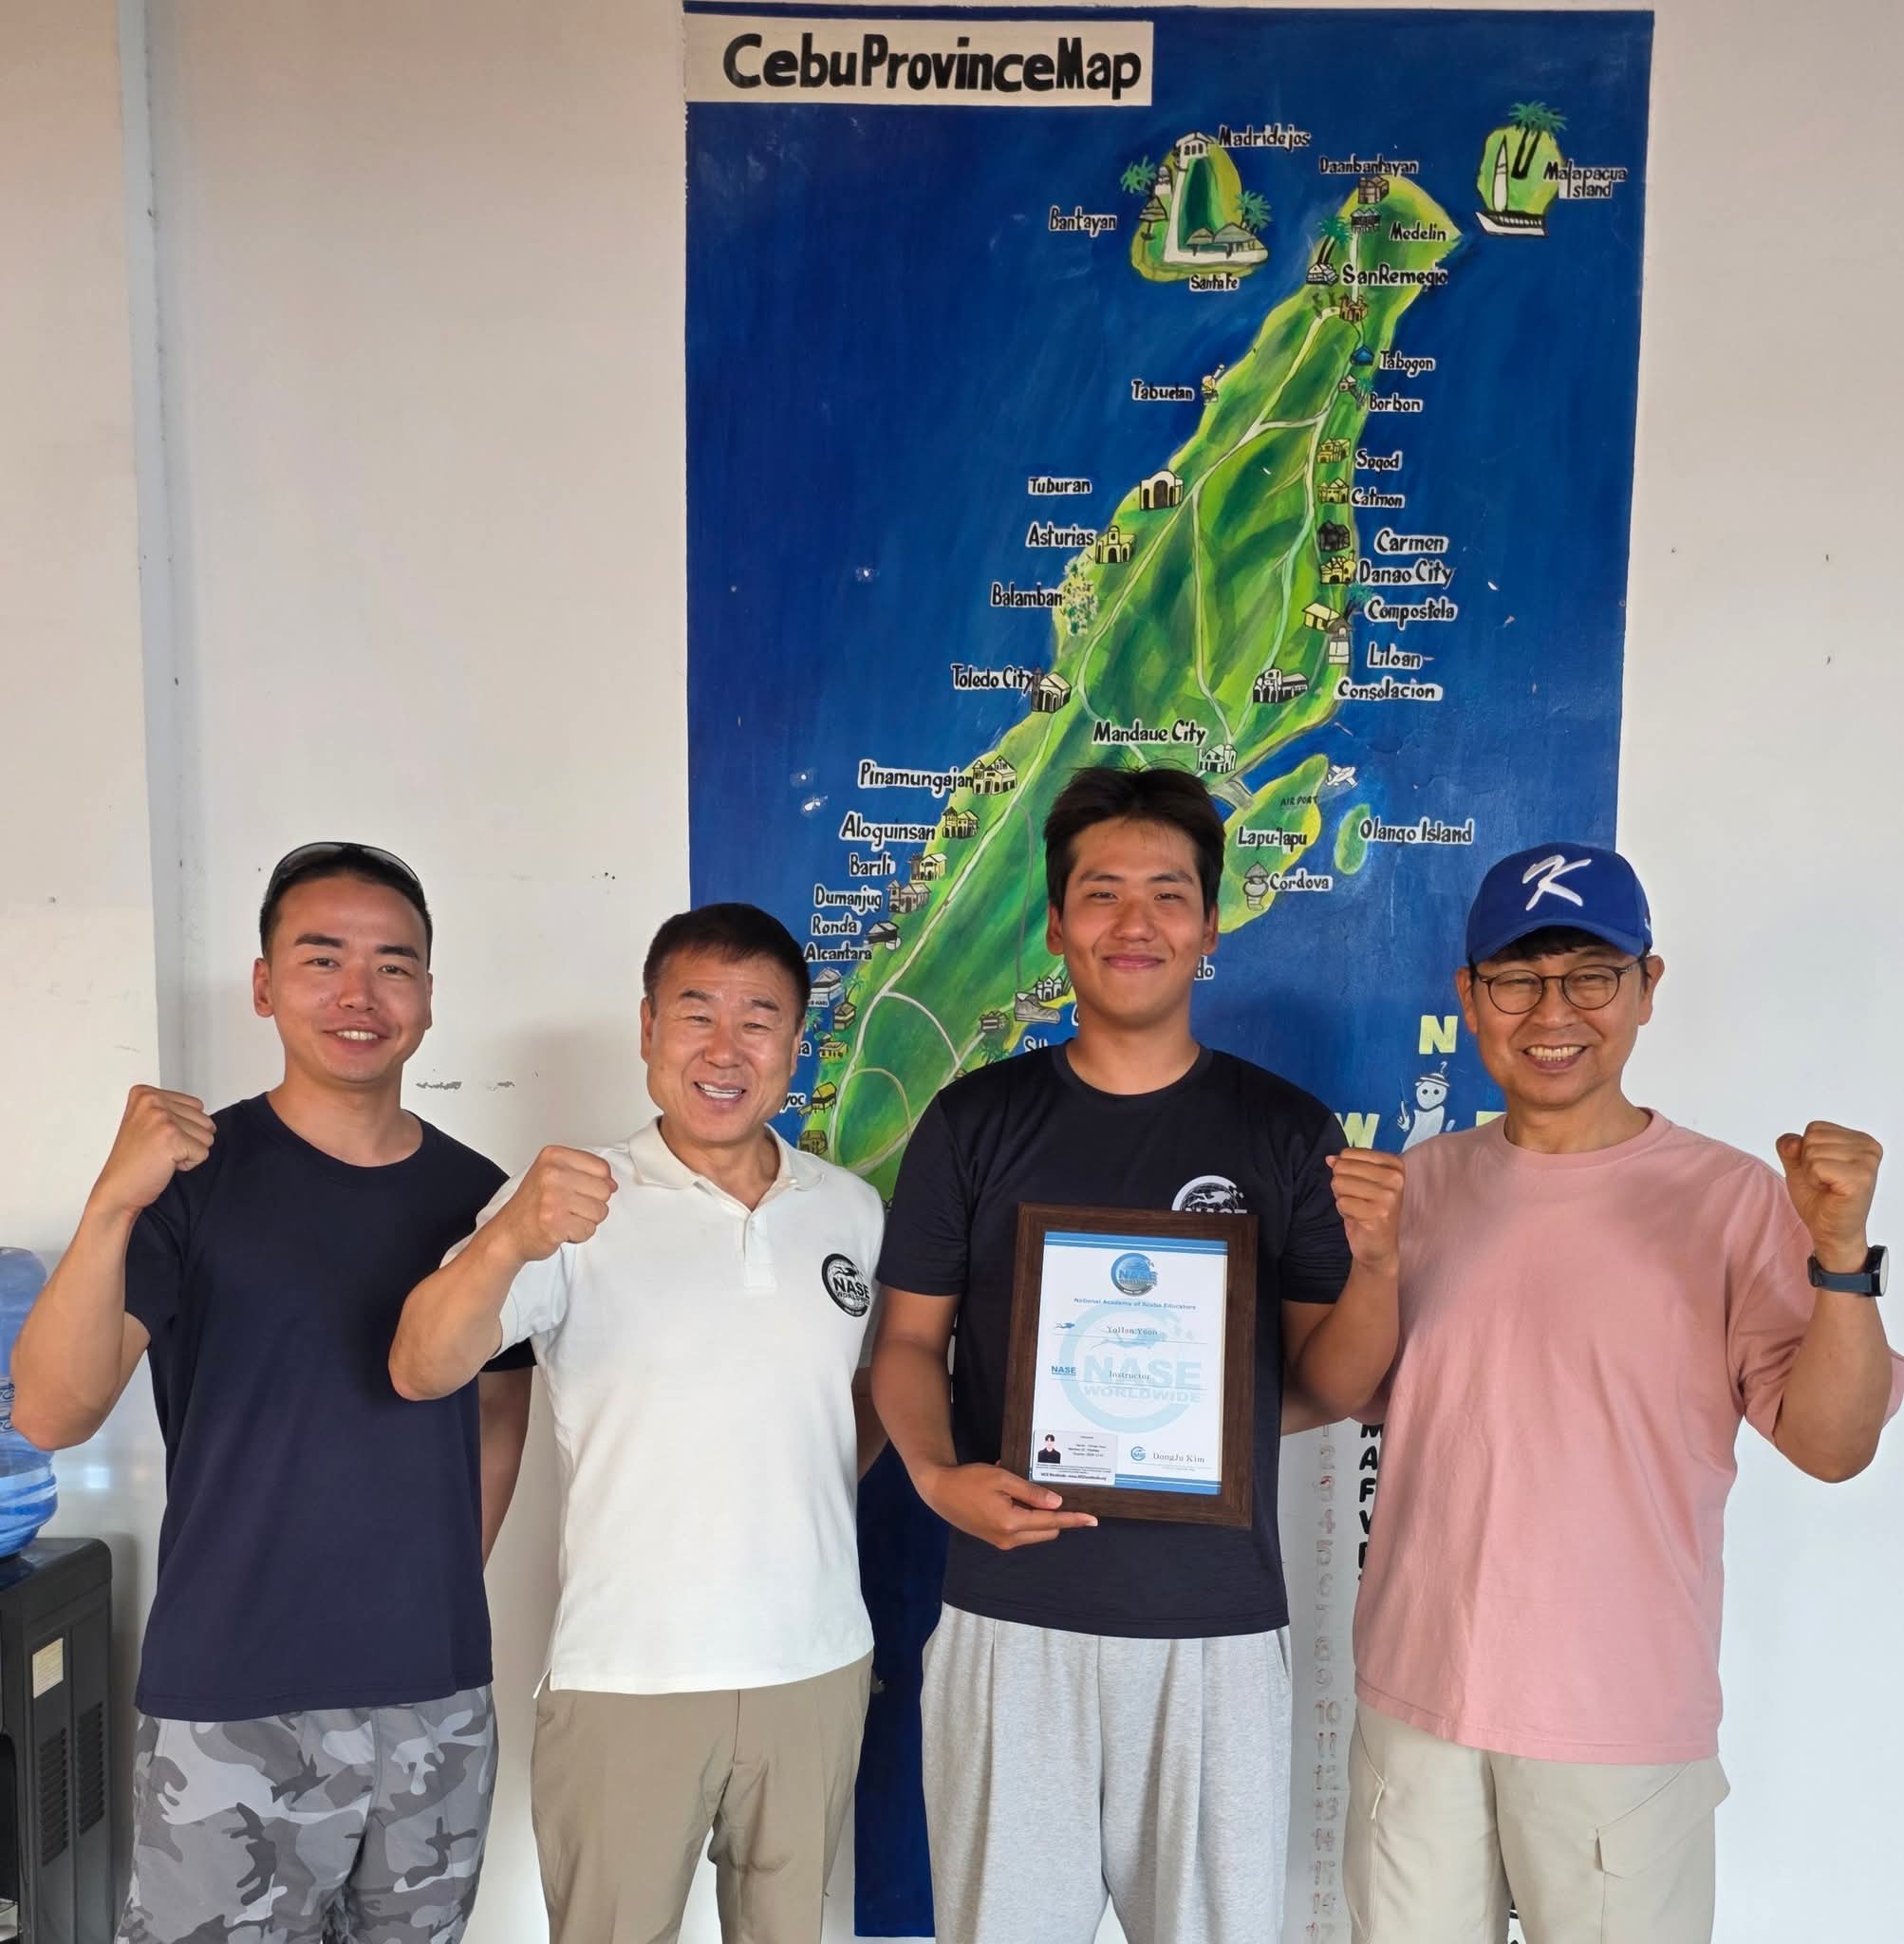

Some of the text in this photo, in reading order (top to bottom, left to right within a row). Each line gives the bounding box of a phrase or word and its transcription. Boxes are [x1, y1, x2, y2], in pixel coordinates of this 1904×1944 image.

[1219, 124, 1311, 151] Madridejos
[1320, 154, 1418, 177] Daanbantayan
[1050, 206, 1117, 236] Bantayan
[1391, 221, 1447, 241] Medelin
[1380, 351, 1434, 376] Tabogon
[1369, 395, 1421, 411] Borbon
[1030, 477, 1091, 494] Tuburan
[1351, 487, 1404, 507] Catmon
[1028, 523, 1094, 547] Asturias
[1376, 530, 1445, 552] Carmen
[1359, 560, 1454, 588] Danao City
[992, 583, 1063, 607] Balamban
[1367, 597, 1456, 628] Compostela
[1370, 643, 1422, 667] Liloan
[952, 664, 1034, 694] Toledo City
[1337, 679, 1435, 700] Consolacion
[1093, 720, 1206, 745] Mandaue City
[860, 761, 973, 794] Pinamungajan
[841, 813, 936, 848] Aloguinsan
[1360, 817, 1472, 843] Olango Island
[850, 853, 892, 876] Barili
[1270, 869, 1330, 890] Cordova
[1521, 854, 1592, 911] K
[815, 885, 882, 913] Dumanjug
[812, 915, 858, 934] Ronda
[805, 943, 872, 962] Alcantara
[1418, 1015, 1458, 1055] N
[833, 1277, 870, 1299] NASE
[1051, 1365, 1076, 1374] NASE
[1109, 1370, 1151, 1380] Instructor
